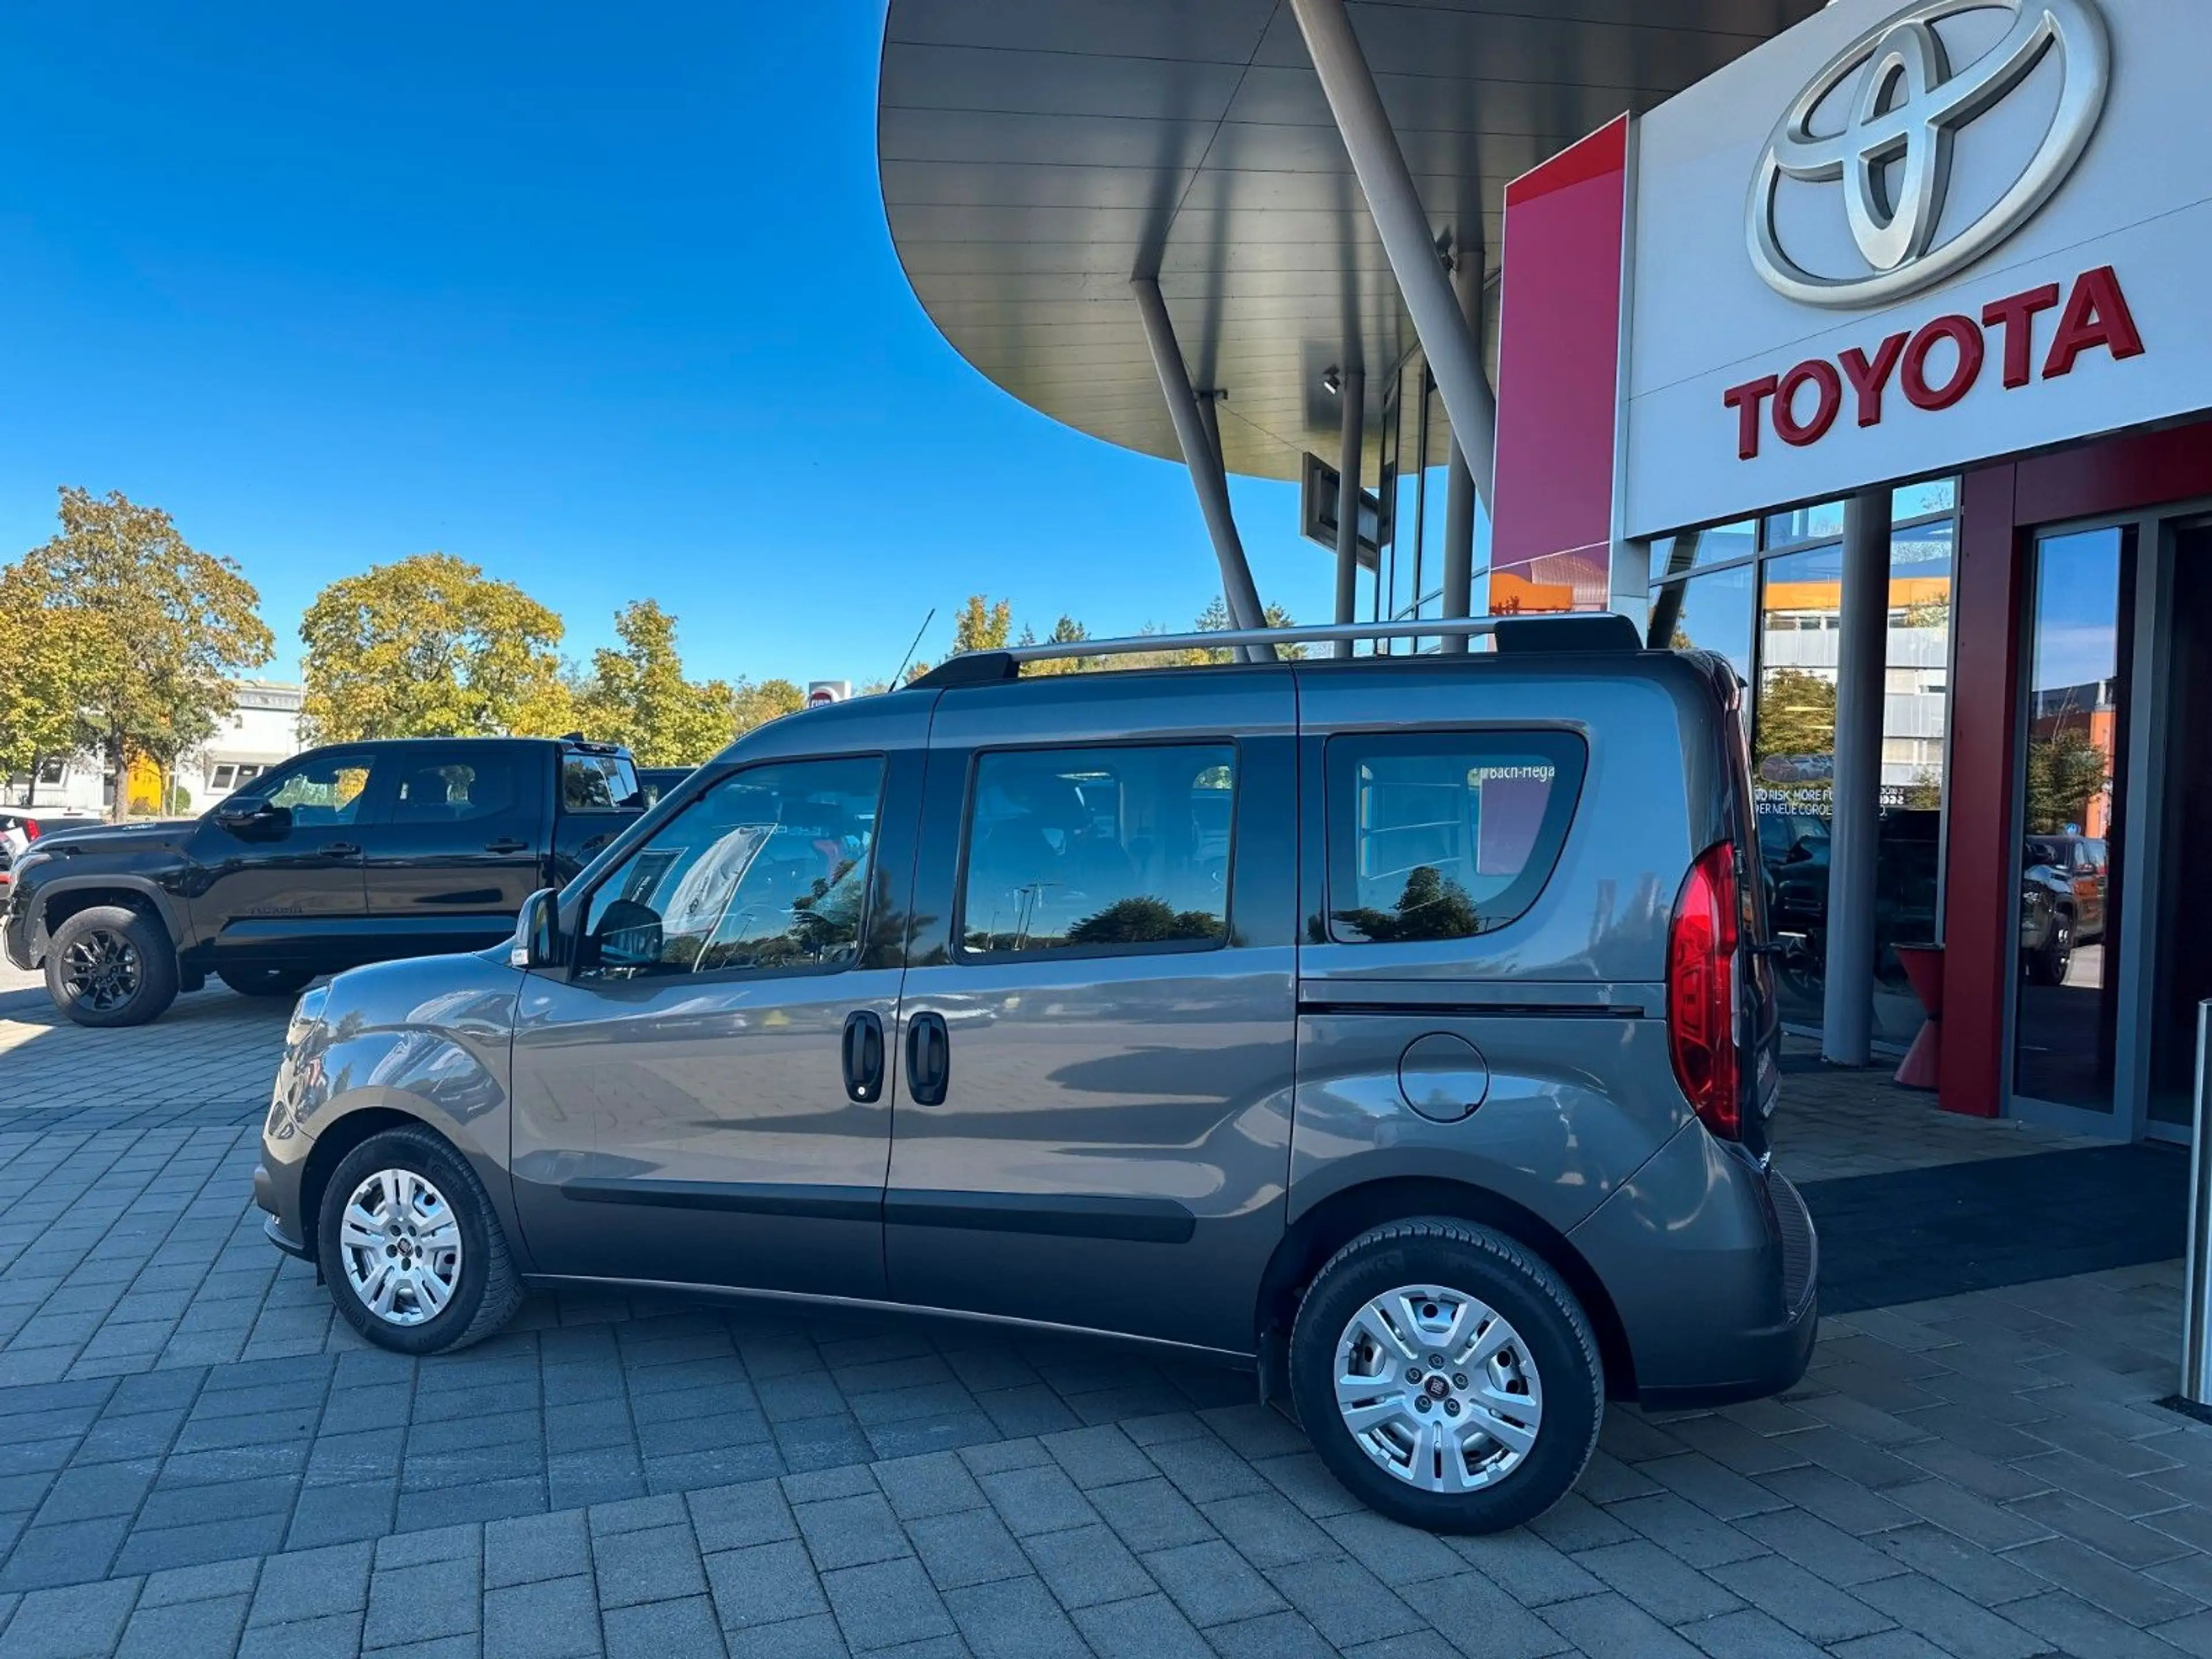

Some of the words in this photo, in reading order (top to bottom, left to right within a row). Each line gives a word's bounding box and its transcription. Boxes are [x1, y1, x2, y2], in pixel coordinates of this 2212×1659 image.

[1724, 265, 2145, 461] TOYOTA
[1794, 789, 1821, 801] MORE
[1772, 803, 1797, 815] NEUE
